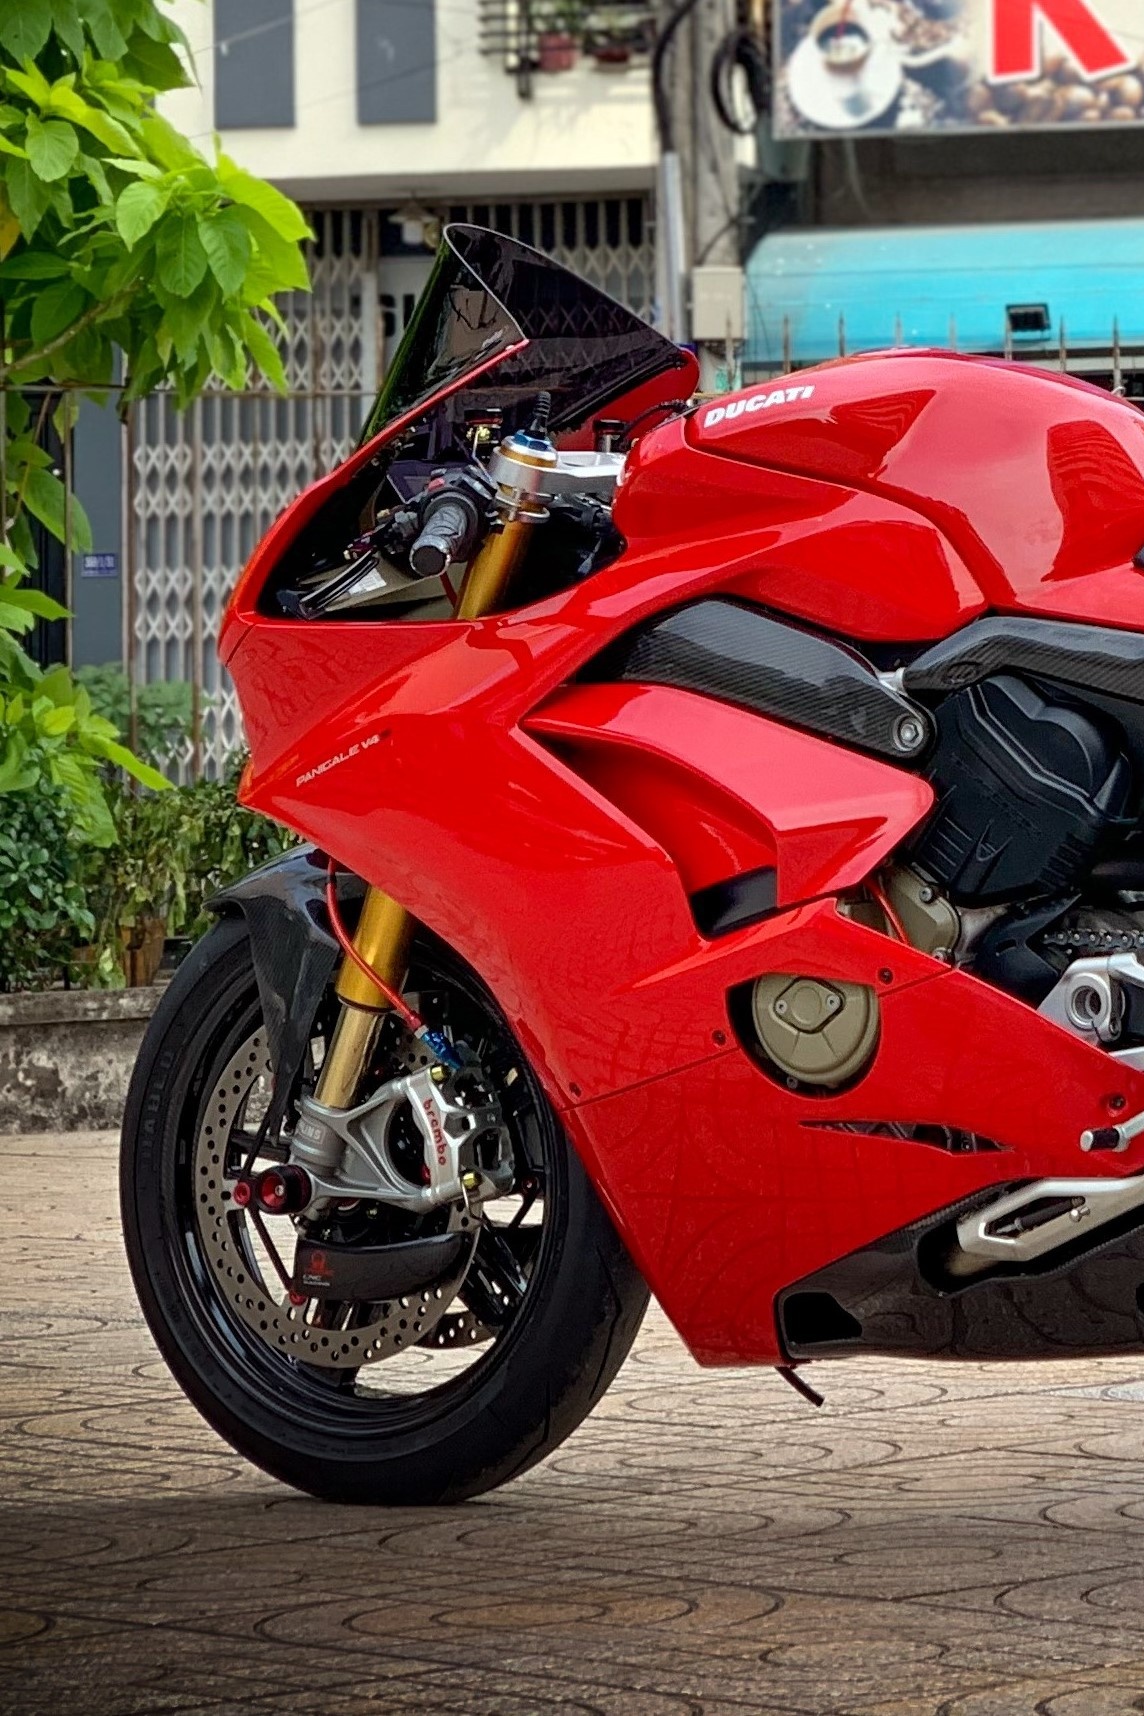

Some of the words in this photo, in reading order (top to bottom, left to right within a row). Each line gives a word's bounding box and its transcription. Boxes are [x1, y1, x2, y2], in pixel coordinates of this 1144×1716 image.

[703, 385, 816, 429] DUCATI
[360, 734, 380, 750] V4
[422, 1097, 447, 1167] brembo
